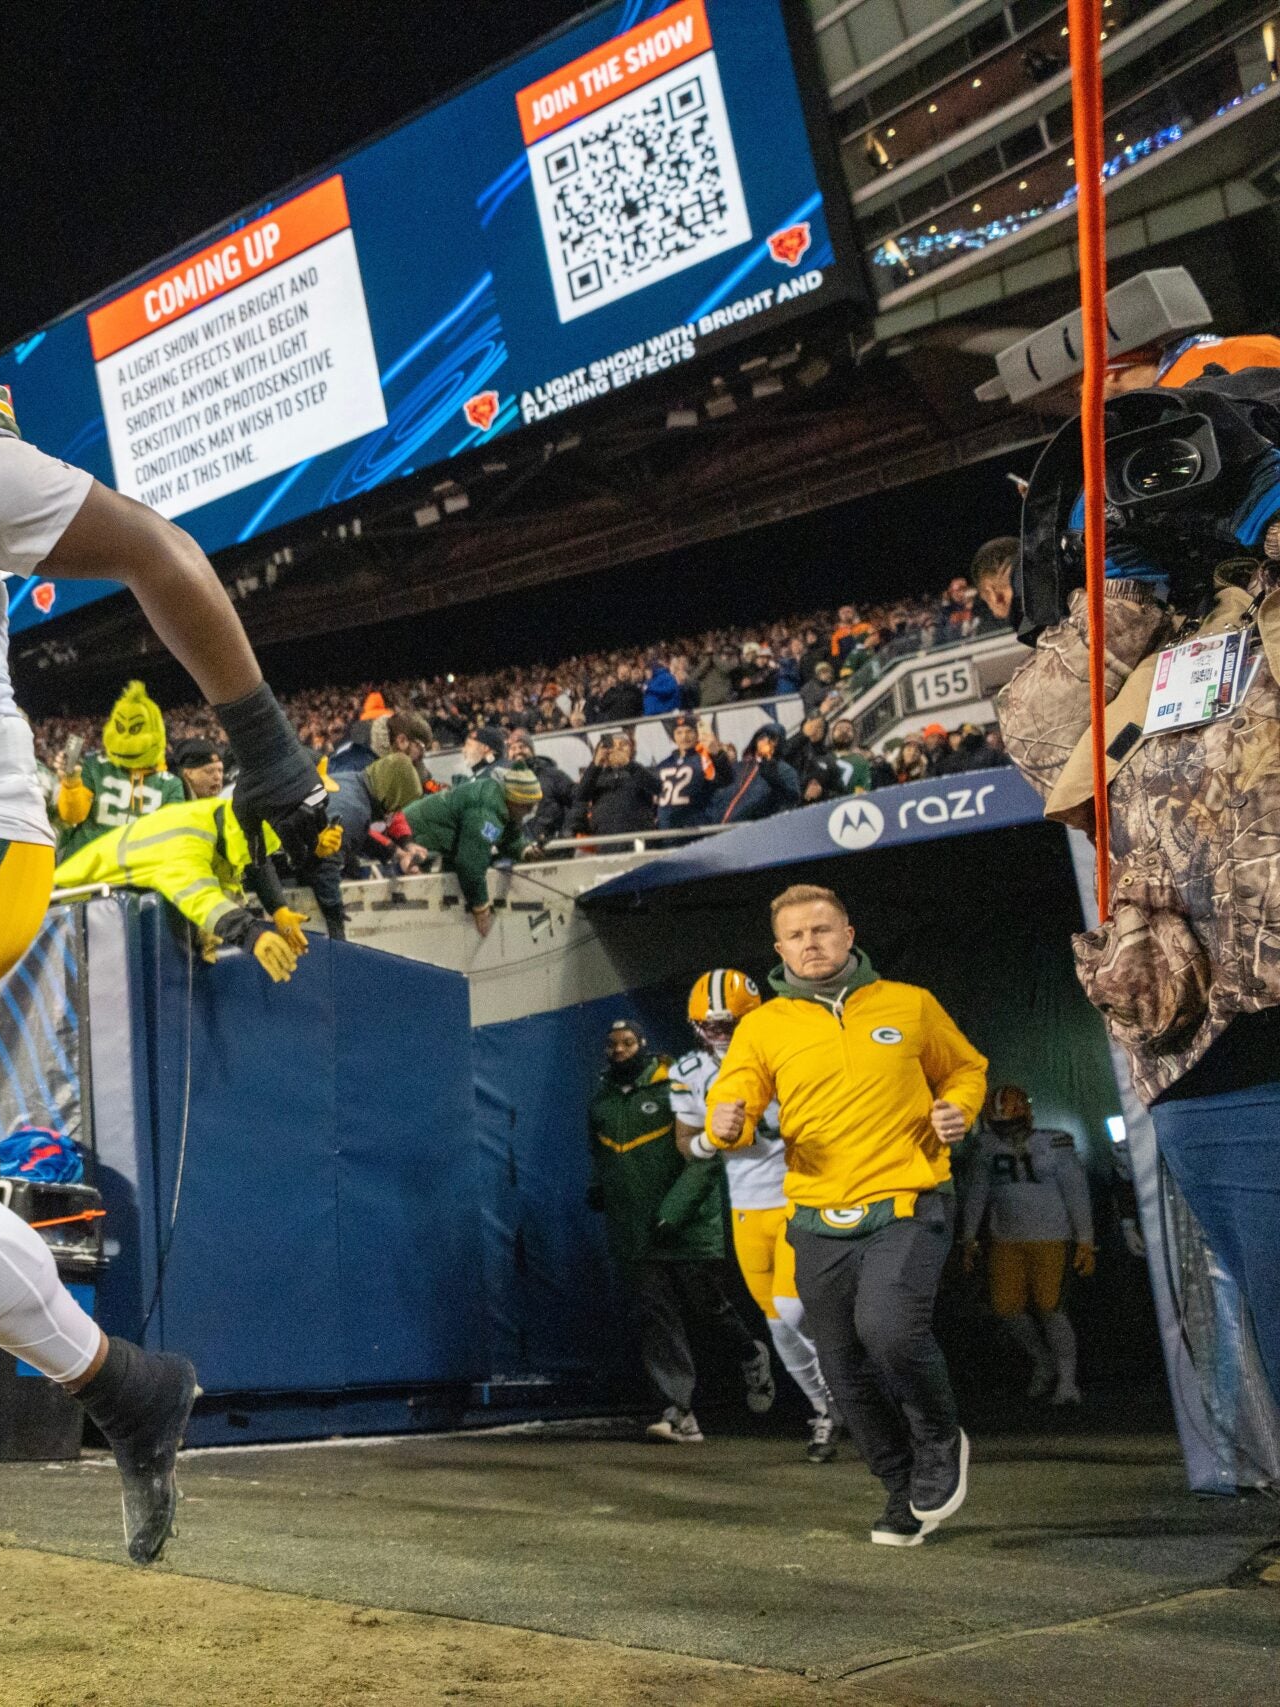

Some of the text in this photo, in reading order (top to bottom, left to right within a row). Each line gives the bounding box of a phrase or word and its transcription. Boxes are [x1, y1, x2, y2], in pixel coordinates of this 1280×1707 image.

[531, 14, 694, 126] JOIN THE SHOW
[143, 221, 281, 323] COMING UP
[118, 266, 319, 387] A LIGHT SHOW WITH BRIGHT AND
[122, 299, 310, 411] FLASHING EFFECTS WILL BEGIN
[181, 369, 231, 410] ANYONE
[232, 350, 268, 383] WITH
[269, 329, 308, 366] LIGHT
[521, 268, 824, 411] A LIGHT SHOW WITH BRIGHT AND
[130, 347, 335, 461] SENSITIVITY OR PHOTOSENSITIVE
[135, 380, 328, 486] CONDITIONS MAY WISH TO STEP
[522, 340, 697, 426] FLASHING EFFECTS
[140, 443, 259, 507] AWAY AT THIS TIME.
[916, 668, 969, 702] 155
[658, 765, 694, 806] 52
[898, 784, 995, 830] razr
